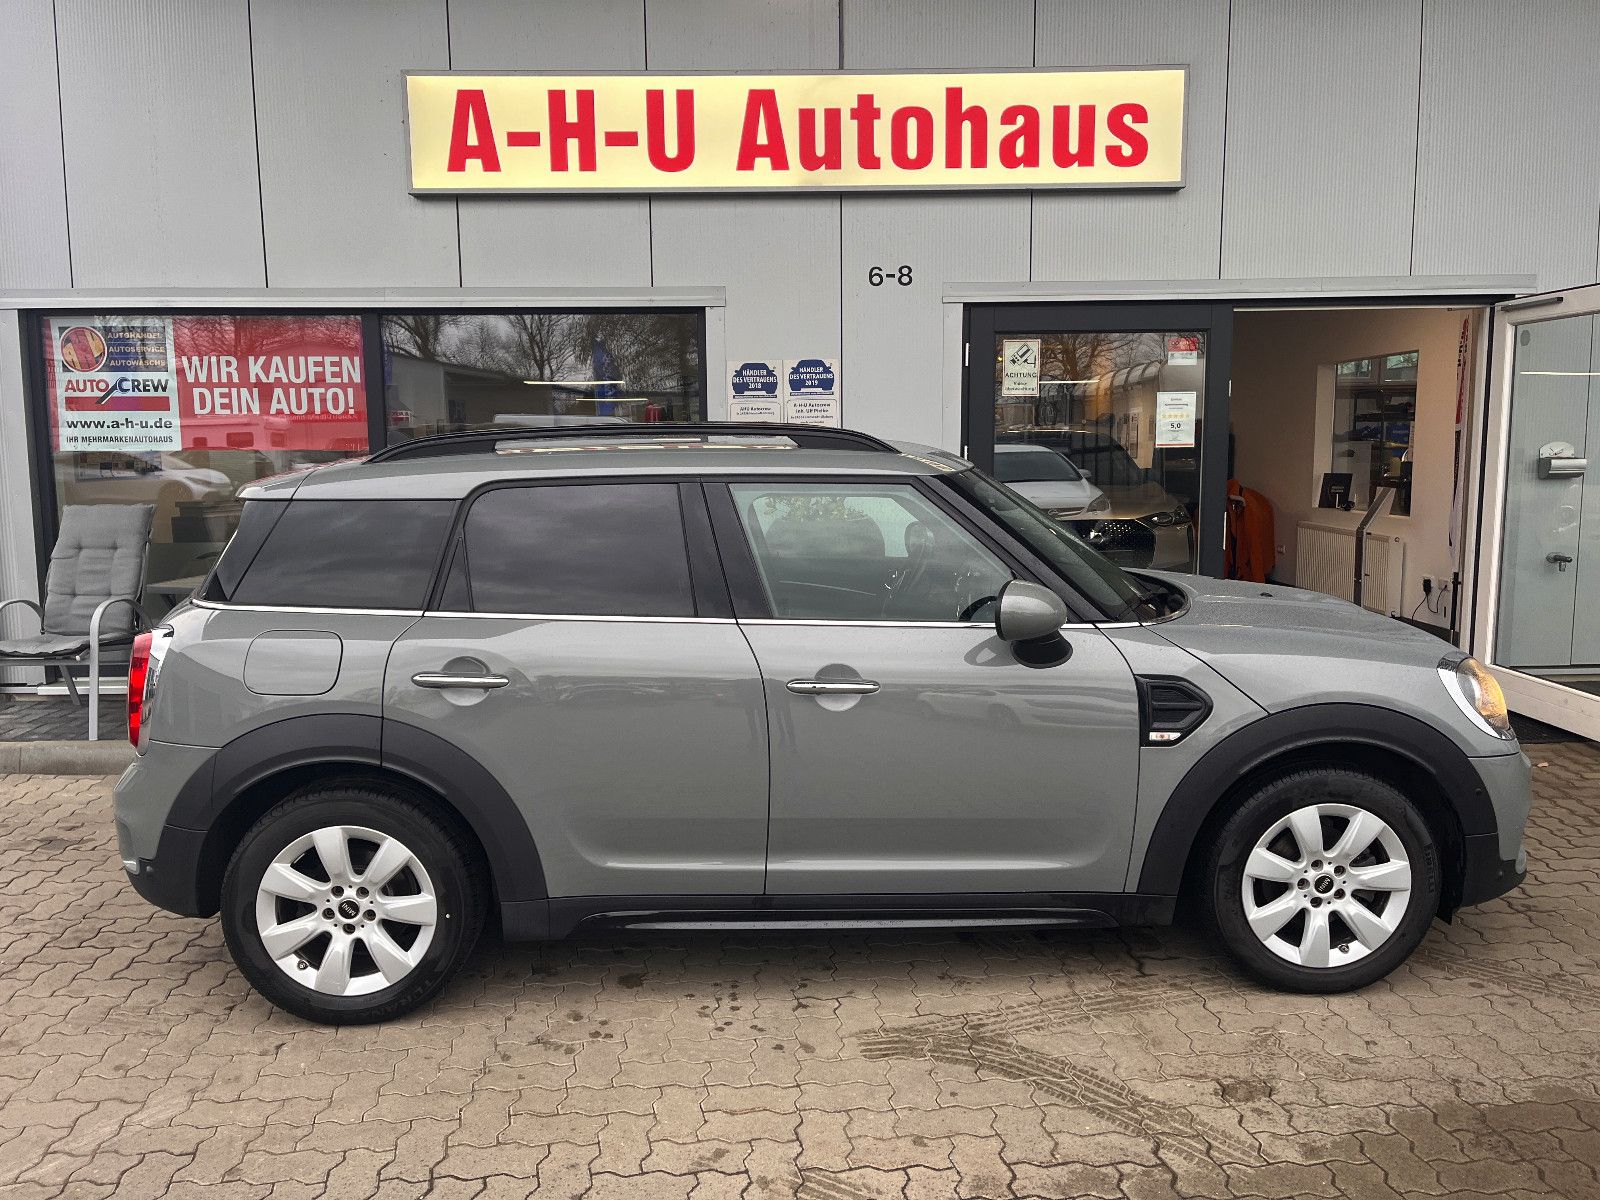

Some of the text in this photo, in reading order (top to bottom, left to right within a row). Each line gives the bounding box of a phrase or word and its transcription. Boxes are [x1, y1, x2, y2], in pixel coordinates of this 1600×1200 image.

[447, 87, 1149, 172] A-H-U Autohaus
[869, 265, 913, 286] 6-8
[182, 356, 361, 383] WIR KAUFEN
[65, 378, 169, 393] AUTO CREW
[192, 388, 355, 415] DEIN AUTO!
[66, 418, 173, 429] www.a-h-u.de
[1170, 422, 1182, 430] 5,0
